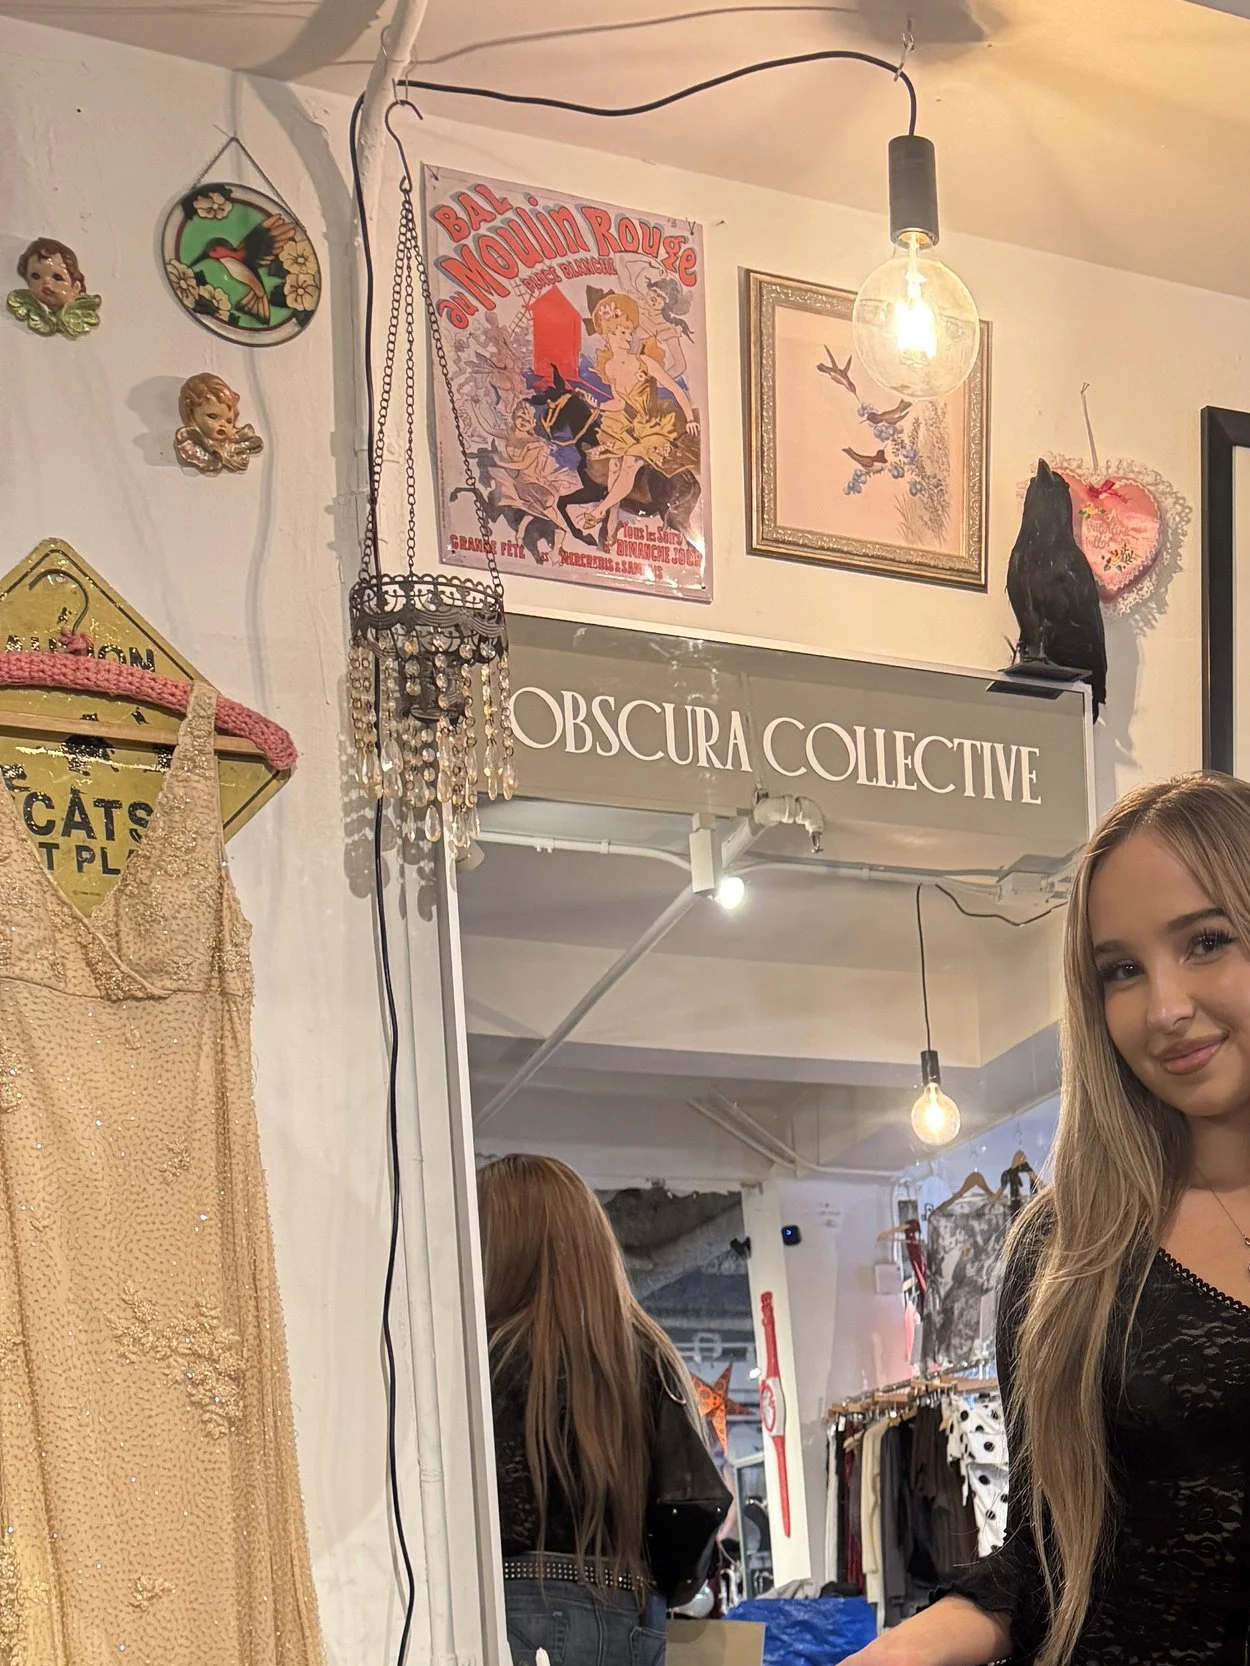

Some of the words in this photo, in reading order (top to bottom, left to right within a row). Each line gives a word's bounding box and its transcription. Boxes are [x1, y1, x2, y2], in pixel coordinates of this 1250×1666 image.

[433, 183, 513, 243] BAL
[522, 267, 563, 294] PLACE
[561, 257, 619, 281] BLANCHE
[500, 540, 526, 560] FÊTE
[621, 559, 664, 580] SAMIS
[616, 539, 671, 564] DIMANCHE
[509, 686, 753, 772] OBSCURA
[762, 716, 1041, 805] COLLECTIVE
[22, 790, 154, 844] CATS
